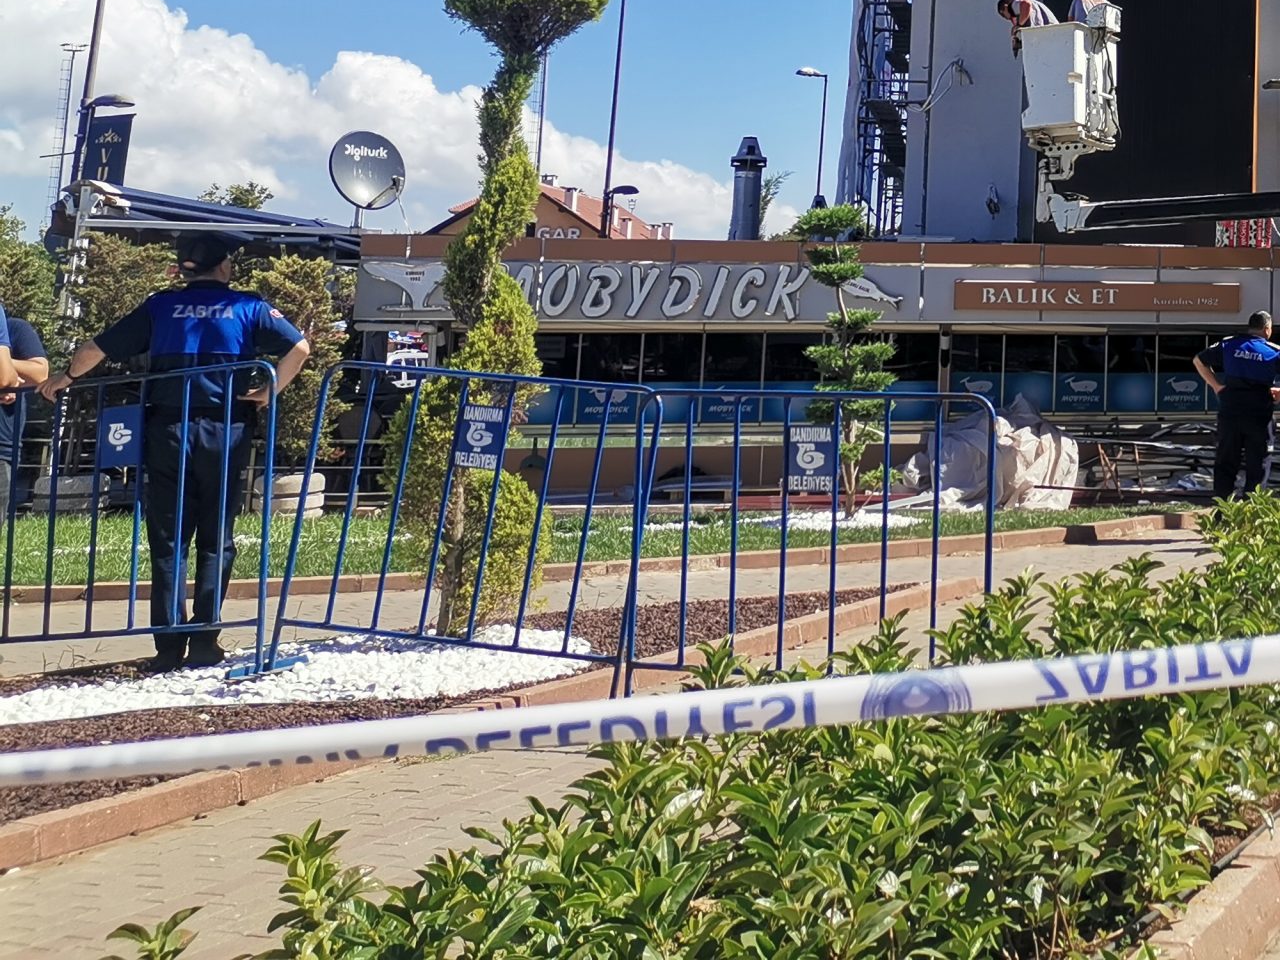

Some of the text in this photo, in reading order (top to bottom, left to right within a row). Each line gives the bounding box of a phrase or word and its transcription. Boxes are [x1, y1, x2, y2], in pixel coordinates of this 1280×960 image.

[536, 227, 581, 239] GAR
[982, 287, 1119, 304] BALIK & ET
[172, 304, 234, 319] ZABITA
[1233, 349, 1263, 362] ZABITA
[464, 405, 504, 422] BANDIRMA
[584, 404, 630, 414] MOBDICK
[789, 427, 832, 443] BANDIRMA
